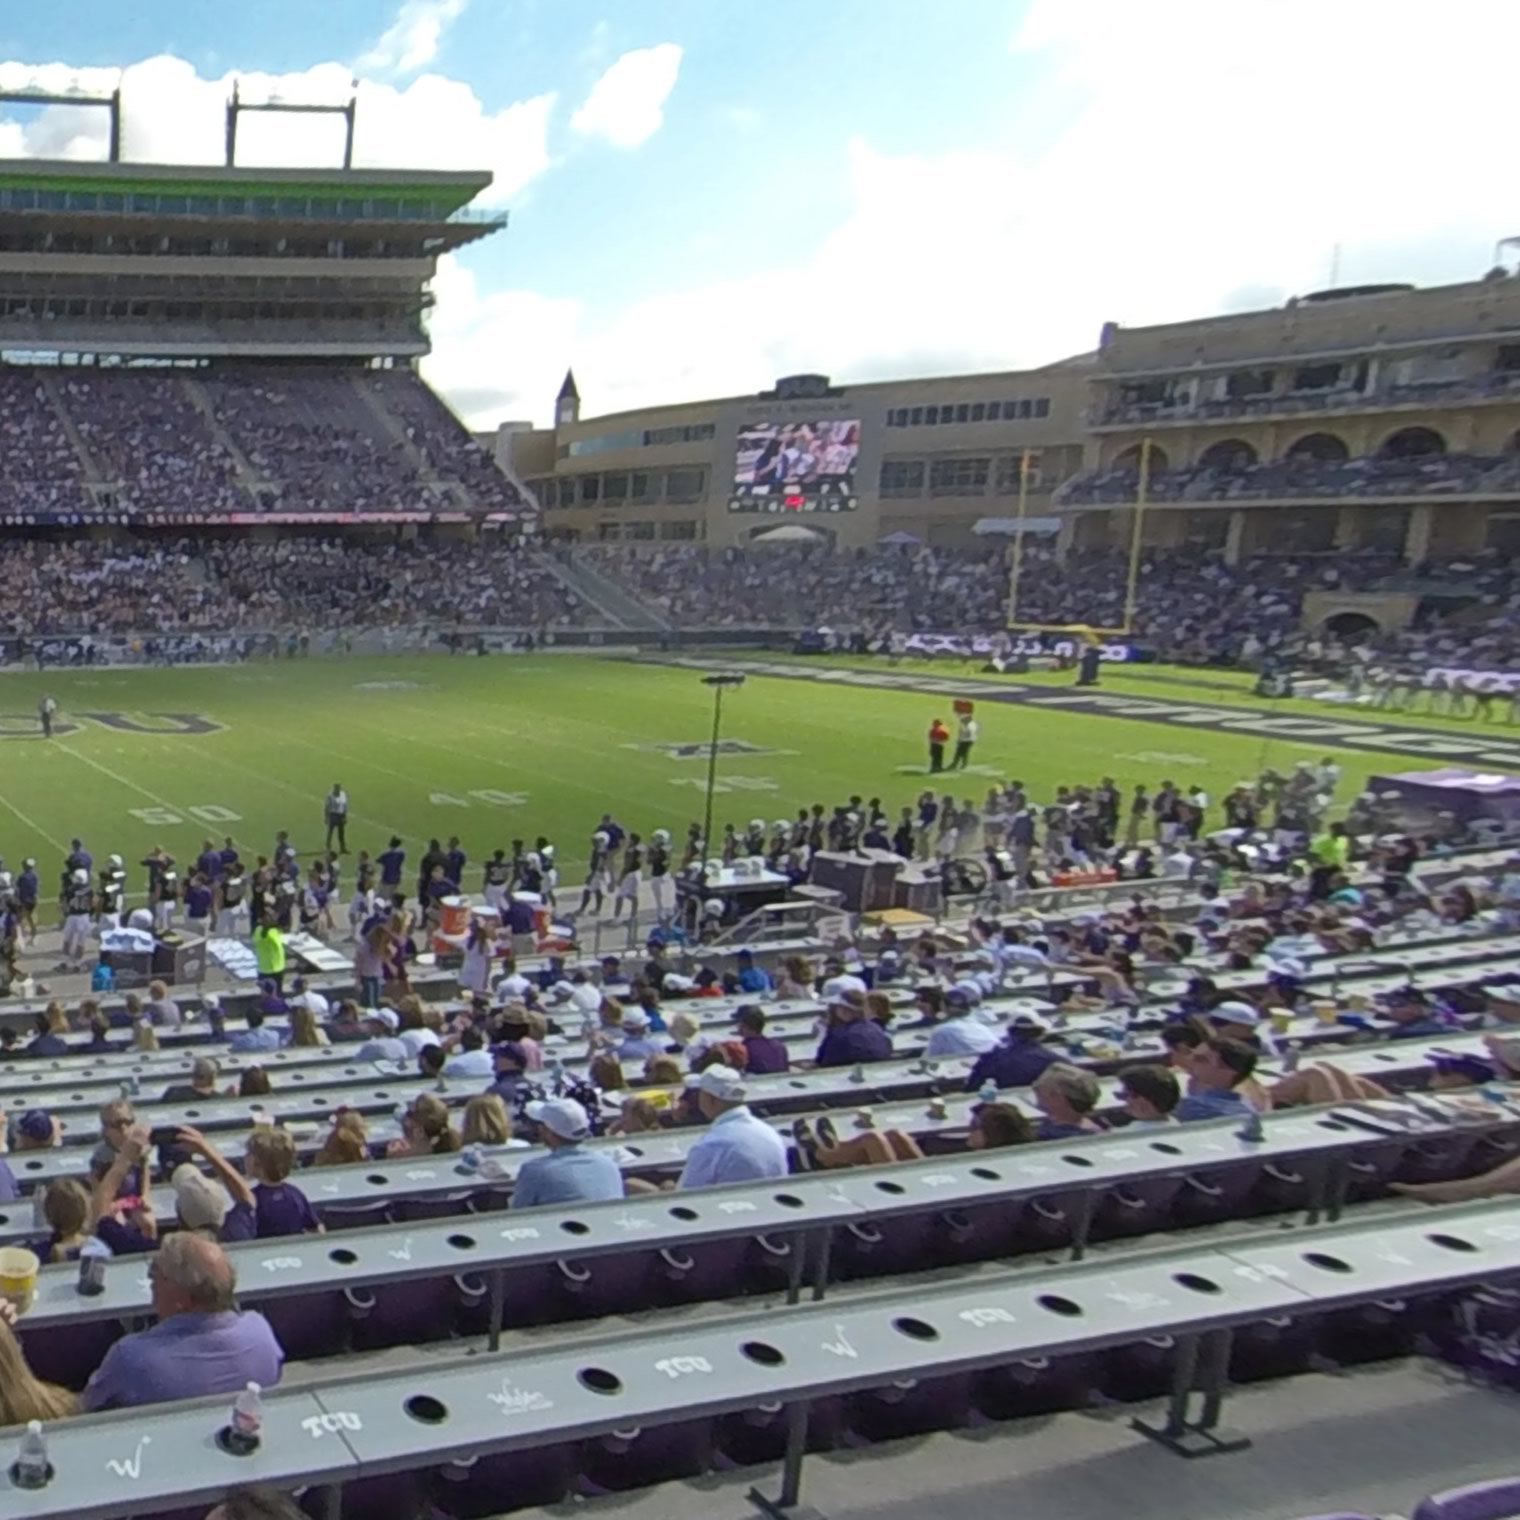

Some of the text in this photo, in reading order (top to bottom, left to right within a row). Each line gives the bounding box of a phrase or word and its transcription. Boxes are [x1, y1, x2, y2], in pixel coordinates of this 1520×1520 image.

[128, 804, 243, 826] 50
[261, 1256, 303, 1272] TCU
[499, 1227, 541, 1242] TCU
[104, 1435, 153, 1479] W
[301, 1411, 363, 1439] TCU
[654, 1356, 714, 1379] TCU
[957, 1307, 1017, 1327] TCU
